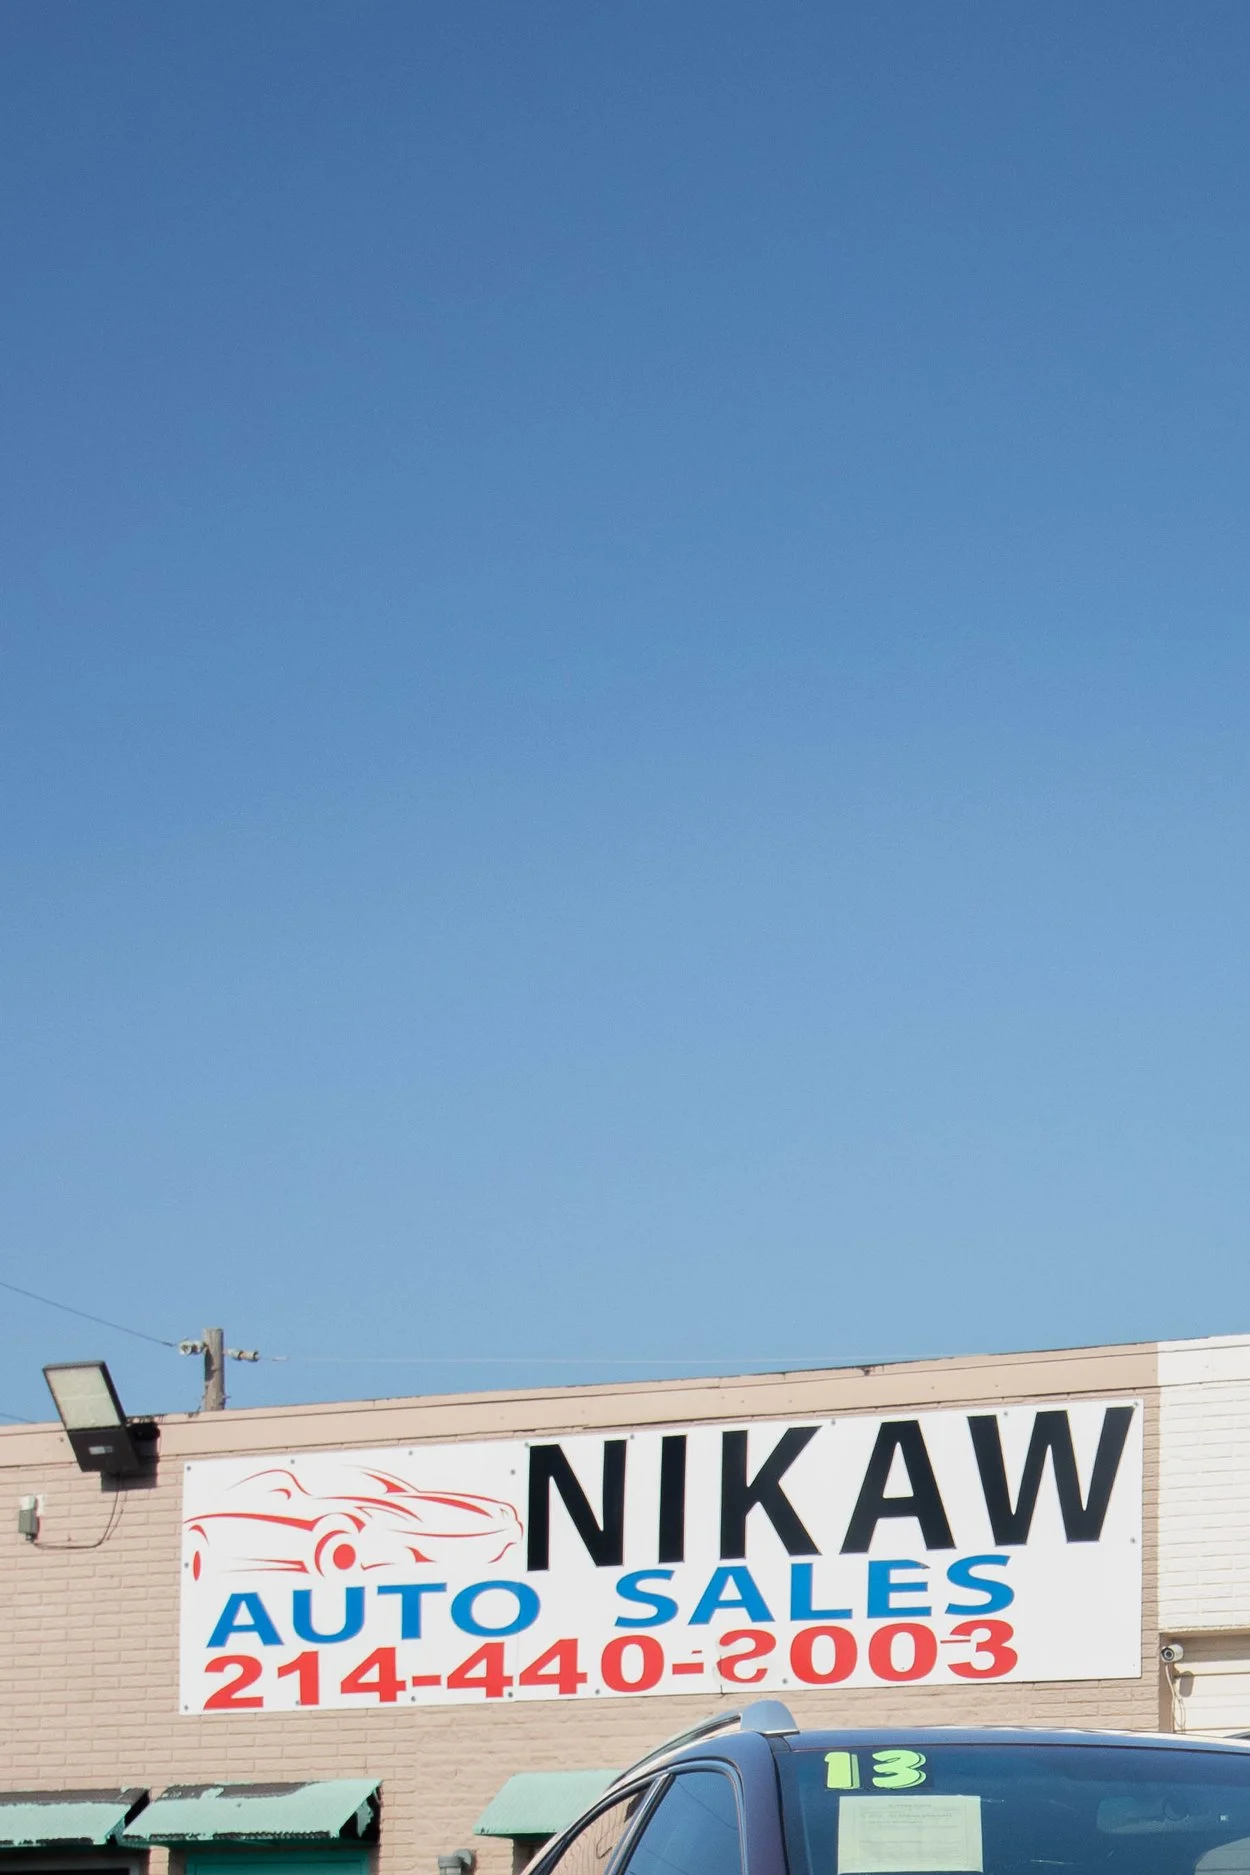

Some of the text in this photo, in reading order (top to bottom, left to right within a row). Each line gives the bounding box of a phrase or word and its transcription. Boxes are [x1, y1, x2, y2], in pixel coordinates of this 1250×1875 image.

[527, 1406, 1134, 1572] NIKAW
[207, 1555, 1014, 1648] AUTO SALES
[824, 1749, 927, 1790] 13
